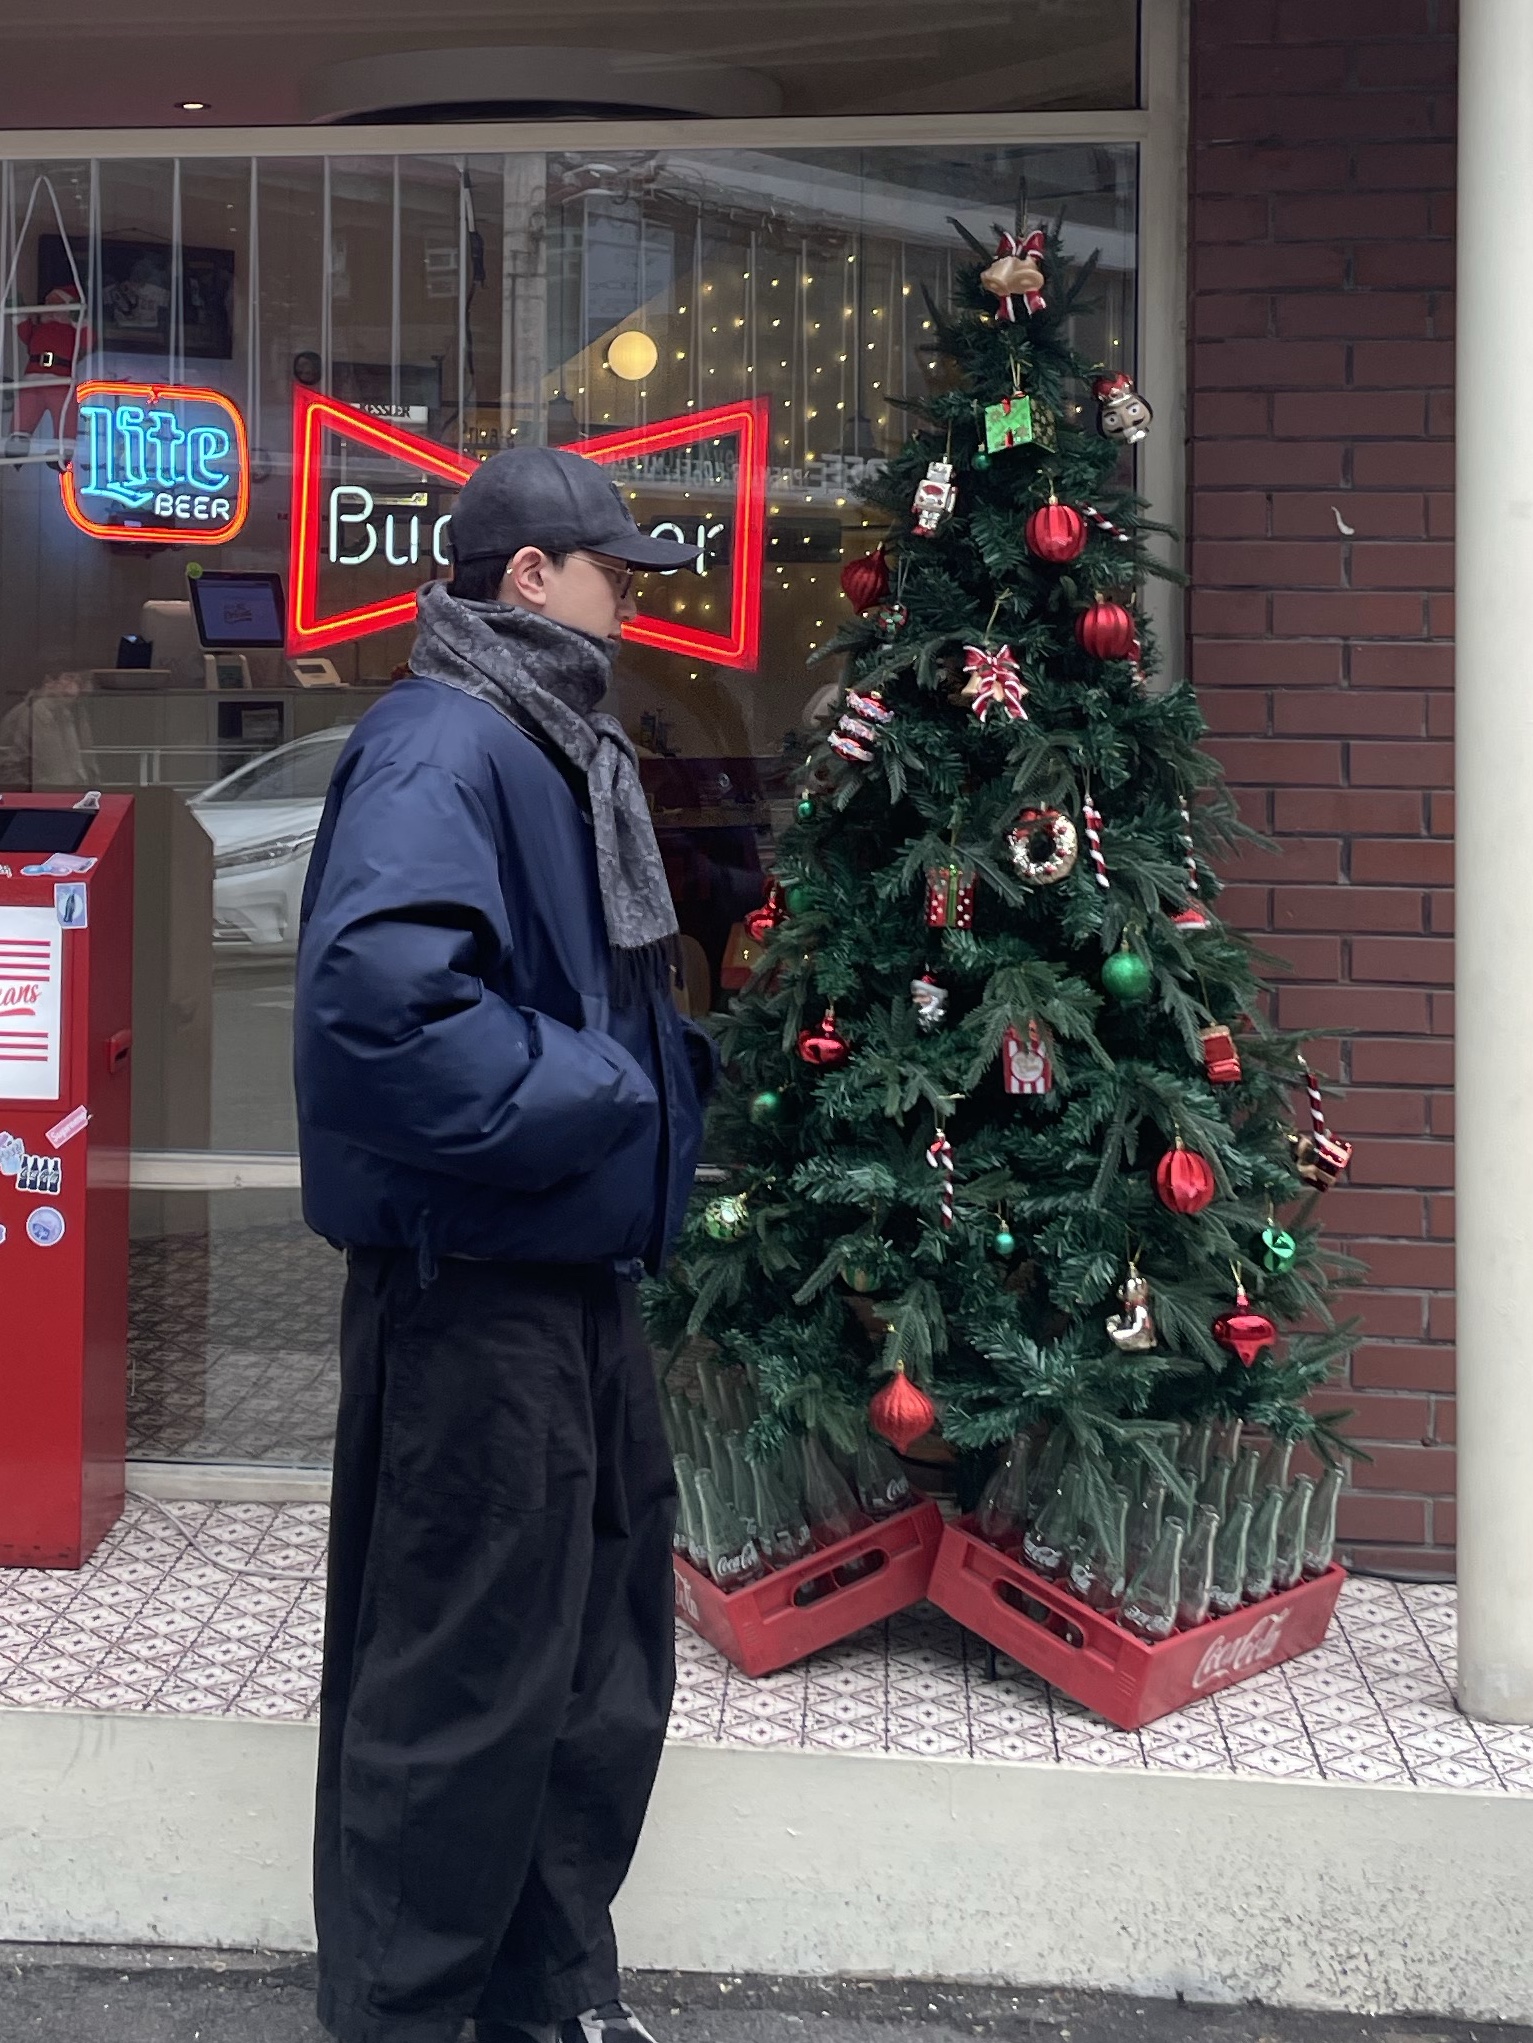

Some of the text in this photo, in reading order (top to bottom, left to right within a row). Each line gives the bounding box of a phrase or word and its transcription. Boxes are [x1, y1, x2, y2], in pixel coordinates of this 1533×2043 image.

[80, 406, 230, 507] Lite
[154, 492, 230, 520] BEER
[0, 984, 42, 1006] ans
